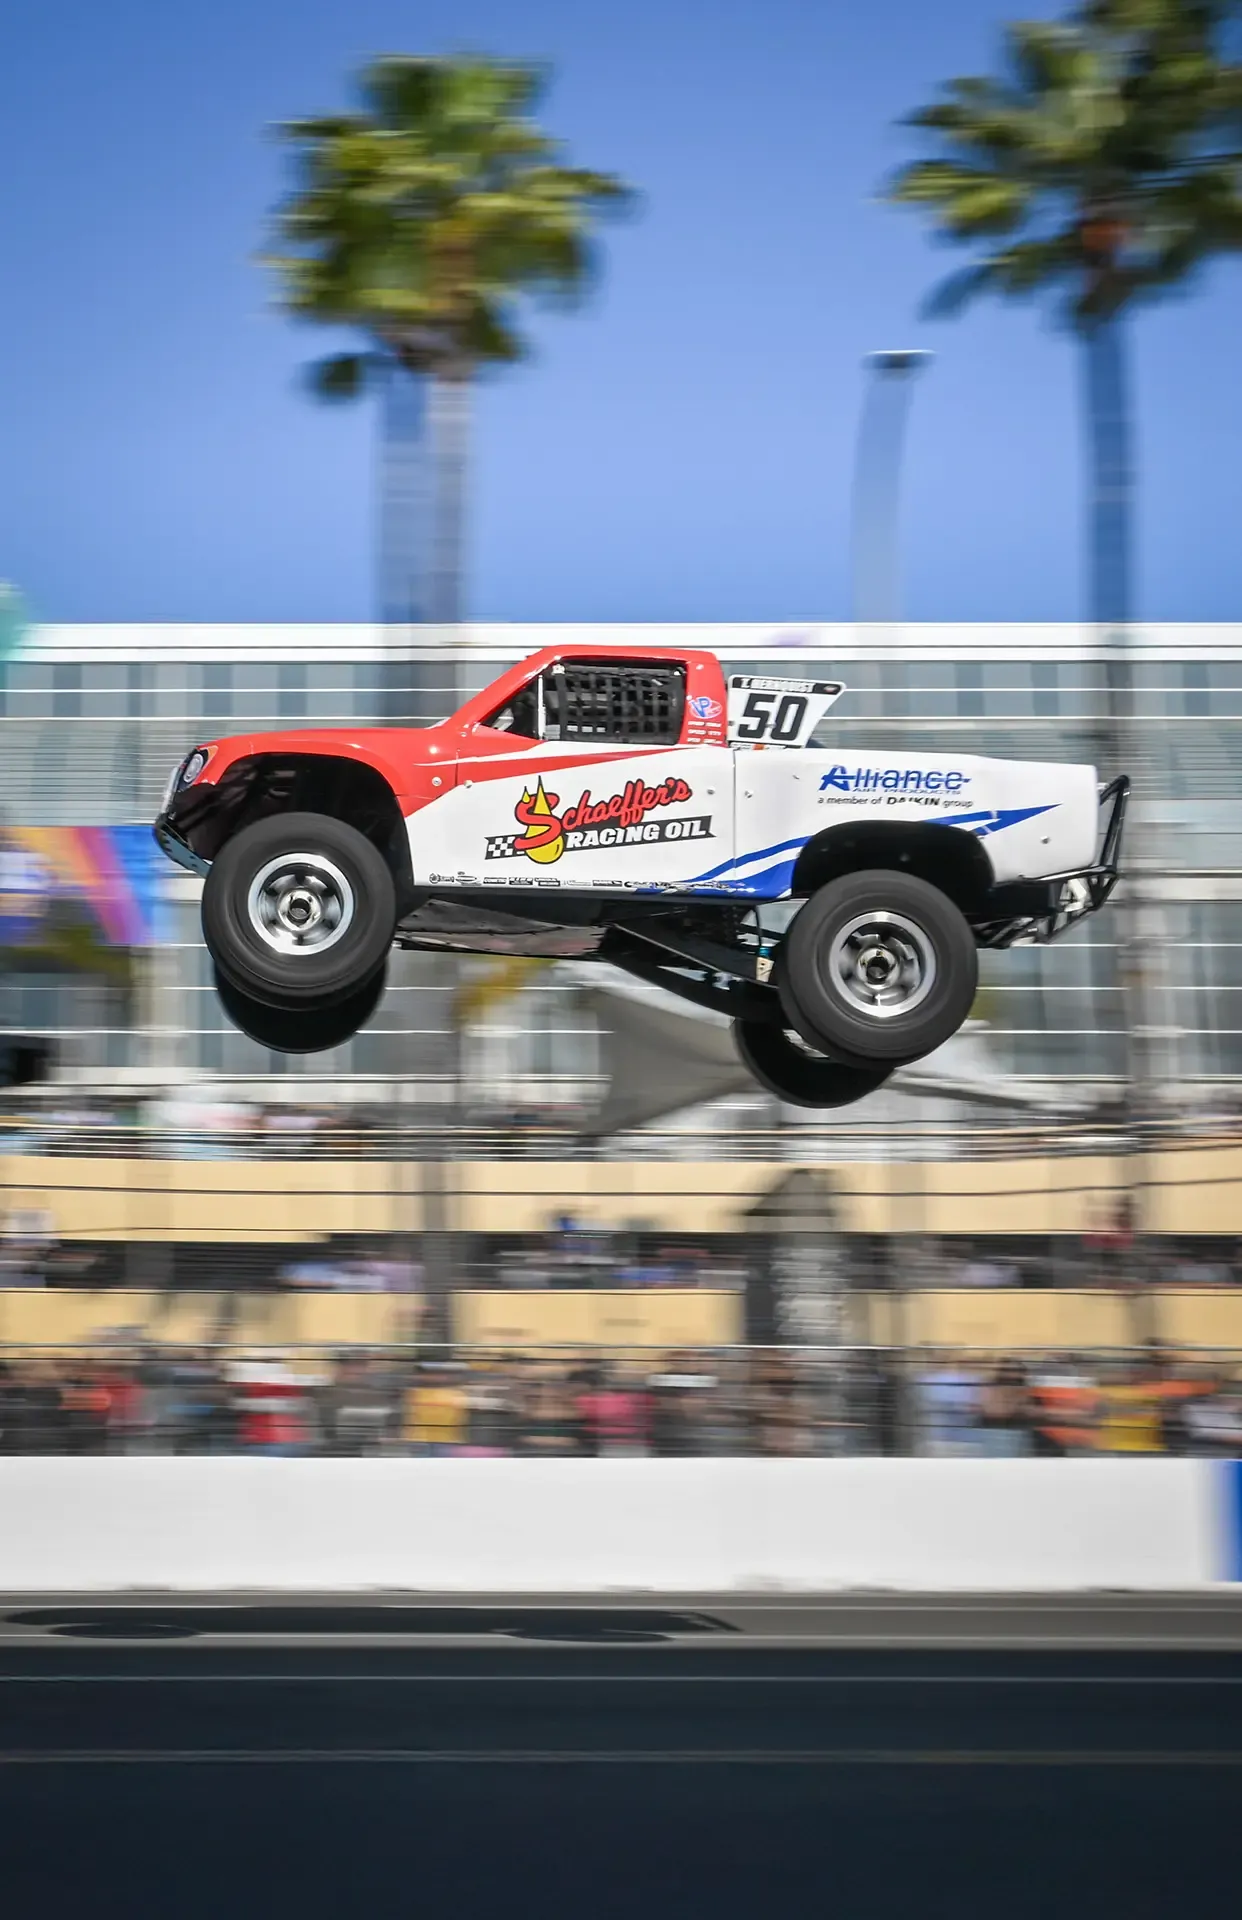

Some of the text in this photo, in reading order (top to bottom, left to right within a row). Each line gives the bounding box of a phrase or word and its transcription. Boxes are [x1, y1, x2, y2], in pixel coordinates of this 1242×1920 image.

[738, 693, 807, 740] 50
[818, 765, 972, 791] Alliance
[513, 777, 693, 850] Schaeffer's
[826, 796, 868, 805] member
[871, 797, 883, 805] of
[943, 799, 974, 809] group
[566, 819, 707, 848] RACING OIL
